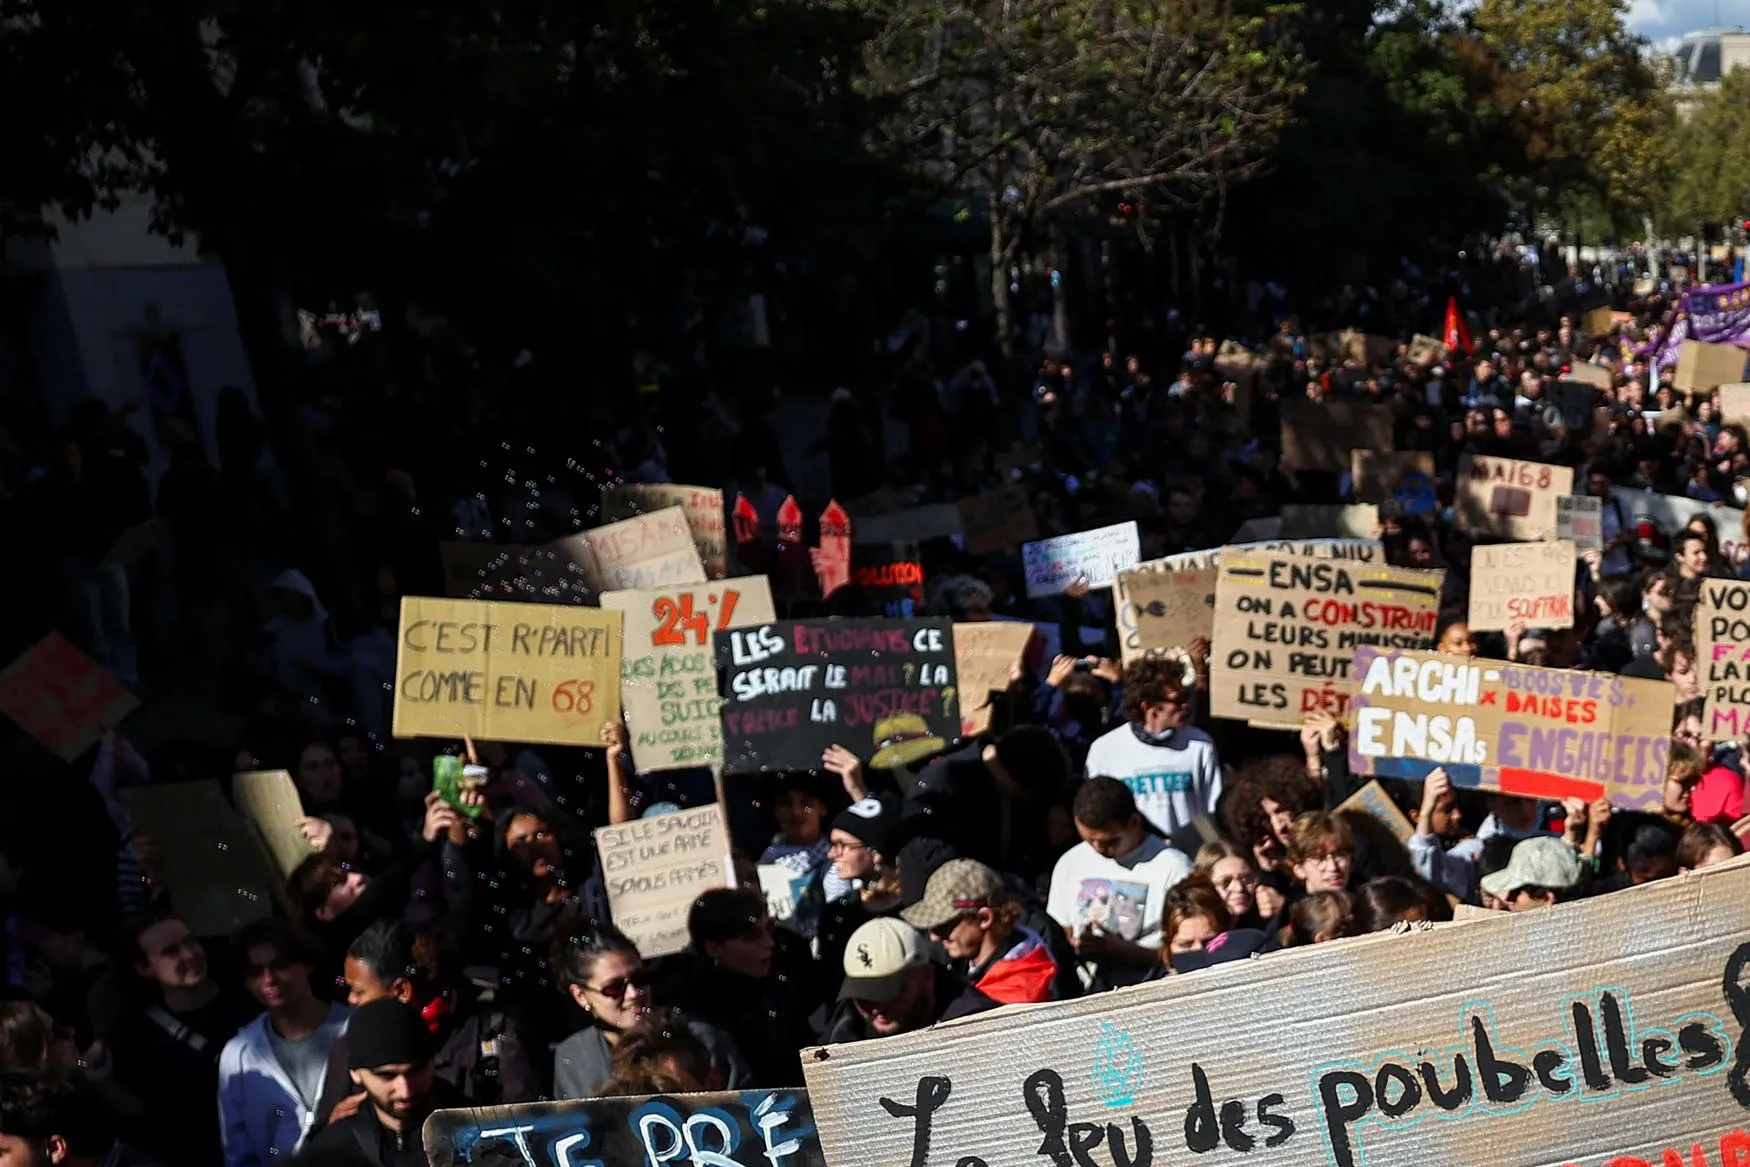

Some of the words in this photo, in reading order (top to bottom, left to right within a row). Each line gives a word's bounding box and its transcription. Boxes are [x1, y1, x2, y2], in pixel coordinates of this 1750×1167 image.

[1269, 560, 1354, 594] ENSA
[1236, 596, 1272, 615] ON
[1279, 602, 1296, 618] A
[404, 620, 498, 653] C'EST
[511, 623, 610, 658] R'PARTI
[731, 625, 787, 666] LES
[913, 628, 943, 652] CE
[1247, 620, 1329, 649] LEURS
[1227, 648, 1272, 670] ON
[1289, 651, 1352, 678] PEUT
[1709, 661, 1740, 682] LA
[401, 670, 484, 704] COMME
[495, 676, 537, 709] EN
[552, 679, 596, 716] 68
[732, 664, 819, 701] SERAIT
[825, 664, 848, 690] LE
[919, 663, 948, 687] LA
[1238, 683, 1289, 709] LES
[1301, 680, 1350, 717] DÉT
[810, 698, 836, 724] LA
[602, 828, 630, 850] SI
[631, 822, 654, 841] LE
[656, 809, 720, 835] SAVOIR
[606, 850, 635, 873] EST
[640, 841, 671, 861] UNE
[1185, 1061, 1296, 1155] des
